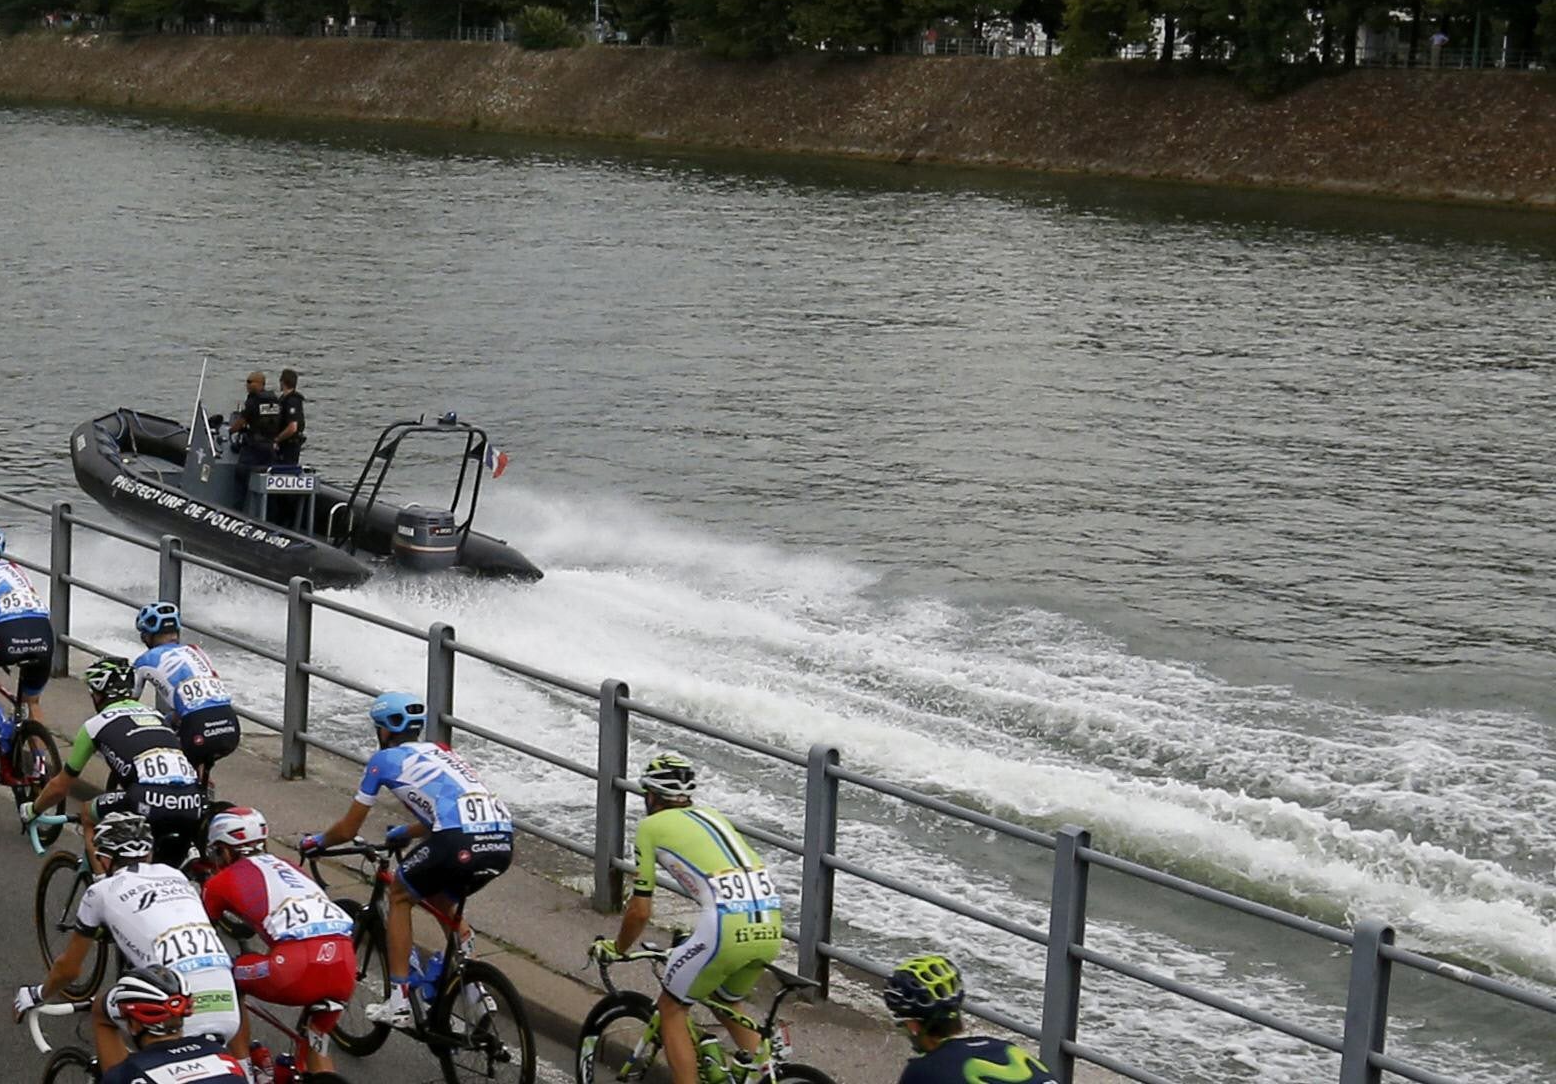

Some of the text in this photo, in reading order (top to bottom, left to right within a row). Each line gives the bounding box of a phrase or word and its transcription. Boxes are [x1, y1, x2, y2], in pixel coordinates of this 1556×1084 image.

[267, 476, 313, 489] POLICE
[183, 502, 206, 519] DE
[203, 509, 253, 538] POLICE
[183, 680, 204, 702] 98
[204, 726, 236, 737] GARMIN
[144, 754, 169, 779] 66
[145, 790, 201, 810] wemo
[465, 797, 487, 822] 97
[471, 843, 511, 853] GARMIN
[474, 833, 506, 842] SHARP
[719, 874, 745, 900] 59
[157, 930, 198, 966] 213
[167, 1061, 206, 1077] IAM
